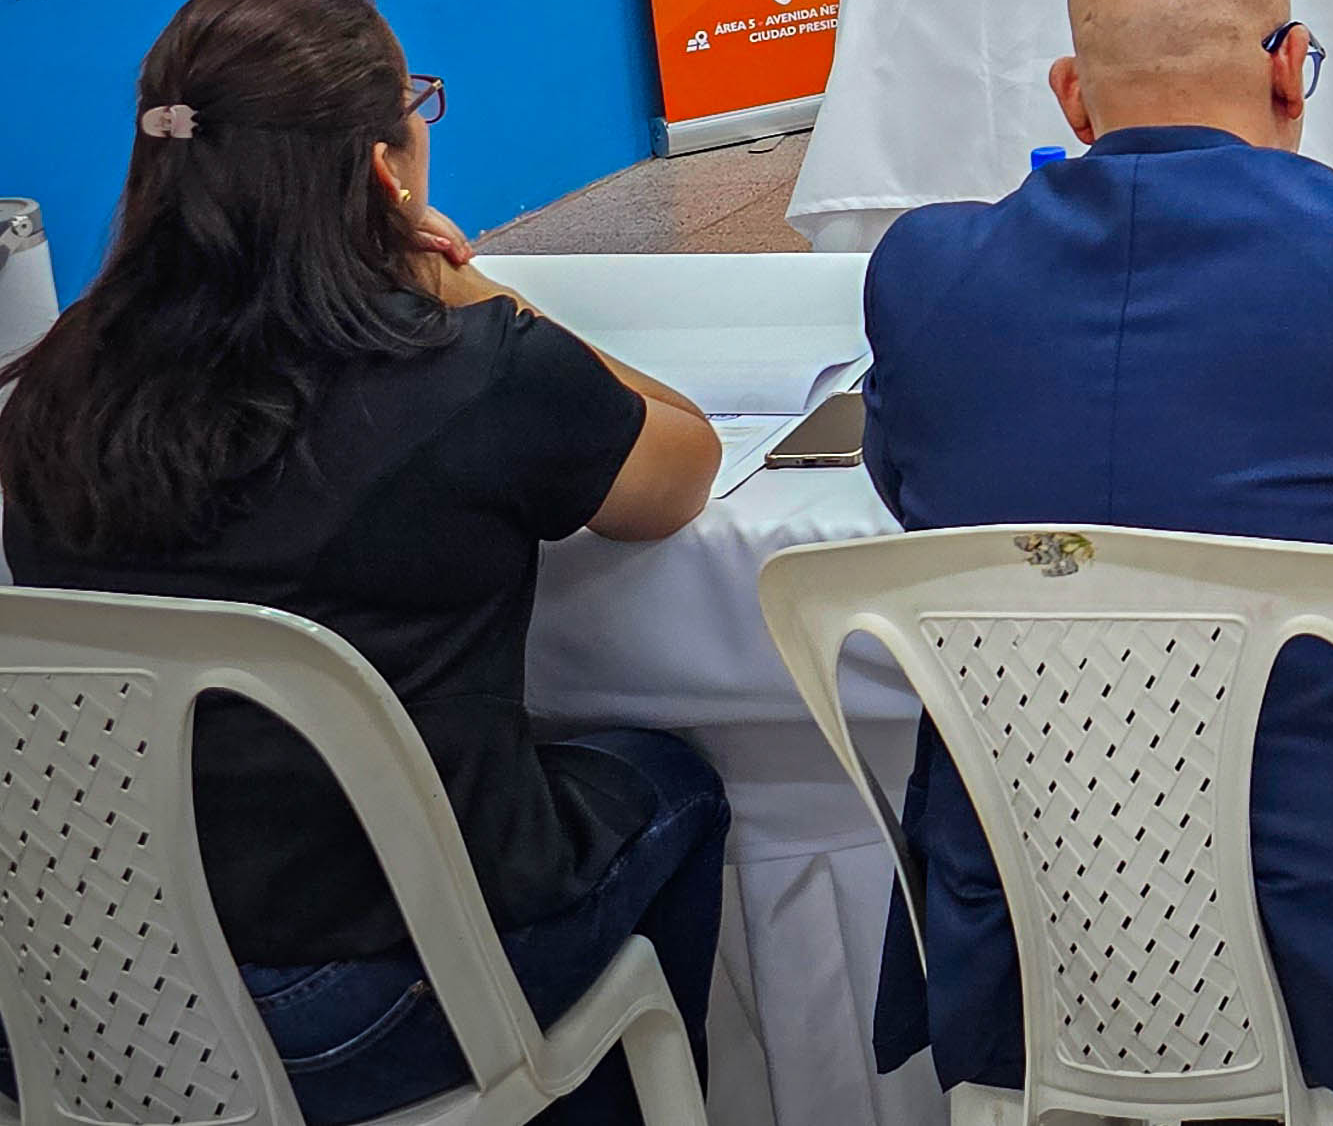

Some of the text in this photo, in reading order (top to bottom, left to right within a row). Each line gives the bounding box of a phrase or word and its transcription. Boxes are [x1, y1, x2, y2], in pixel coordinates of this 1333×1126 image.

[714, 19, 746, 36] ÁREA
[765, 7, 819, 27] AVENIDA
[749, 26, 797, 43] CIUDAD
